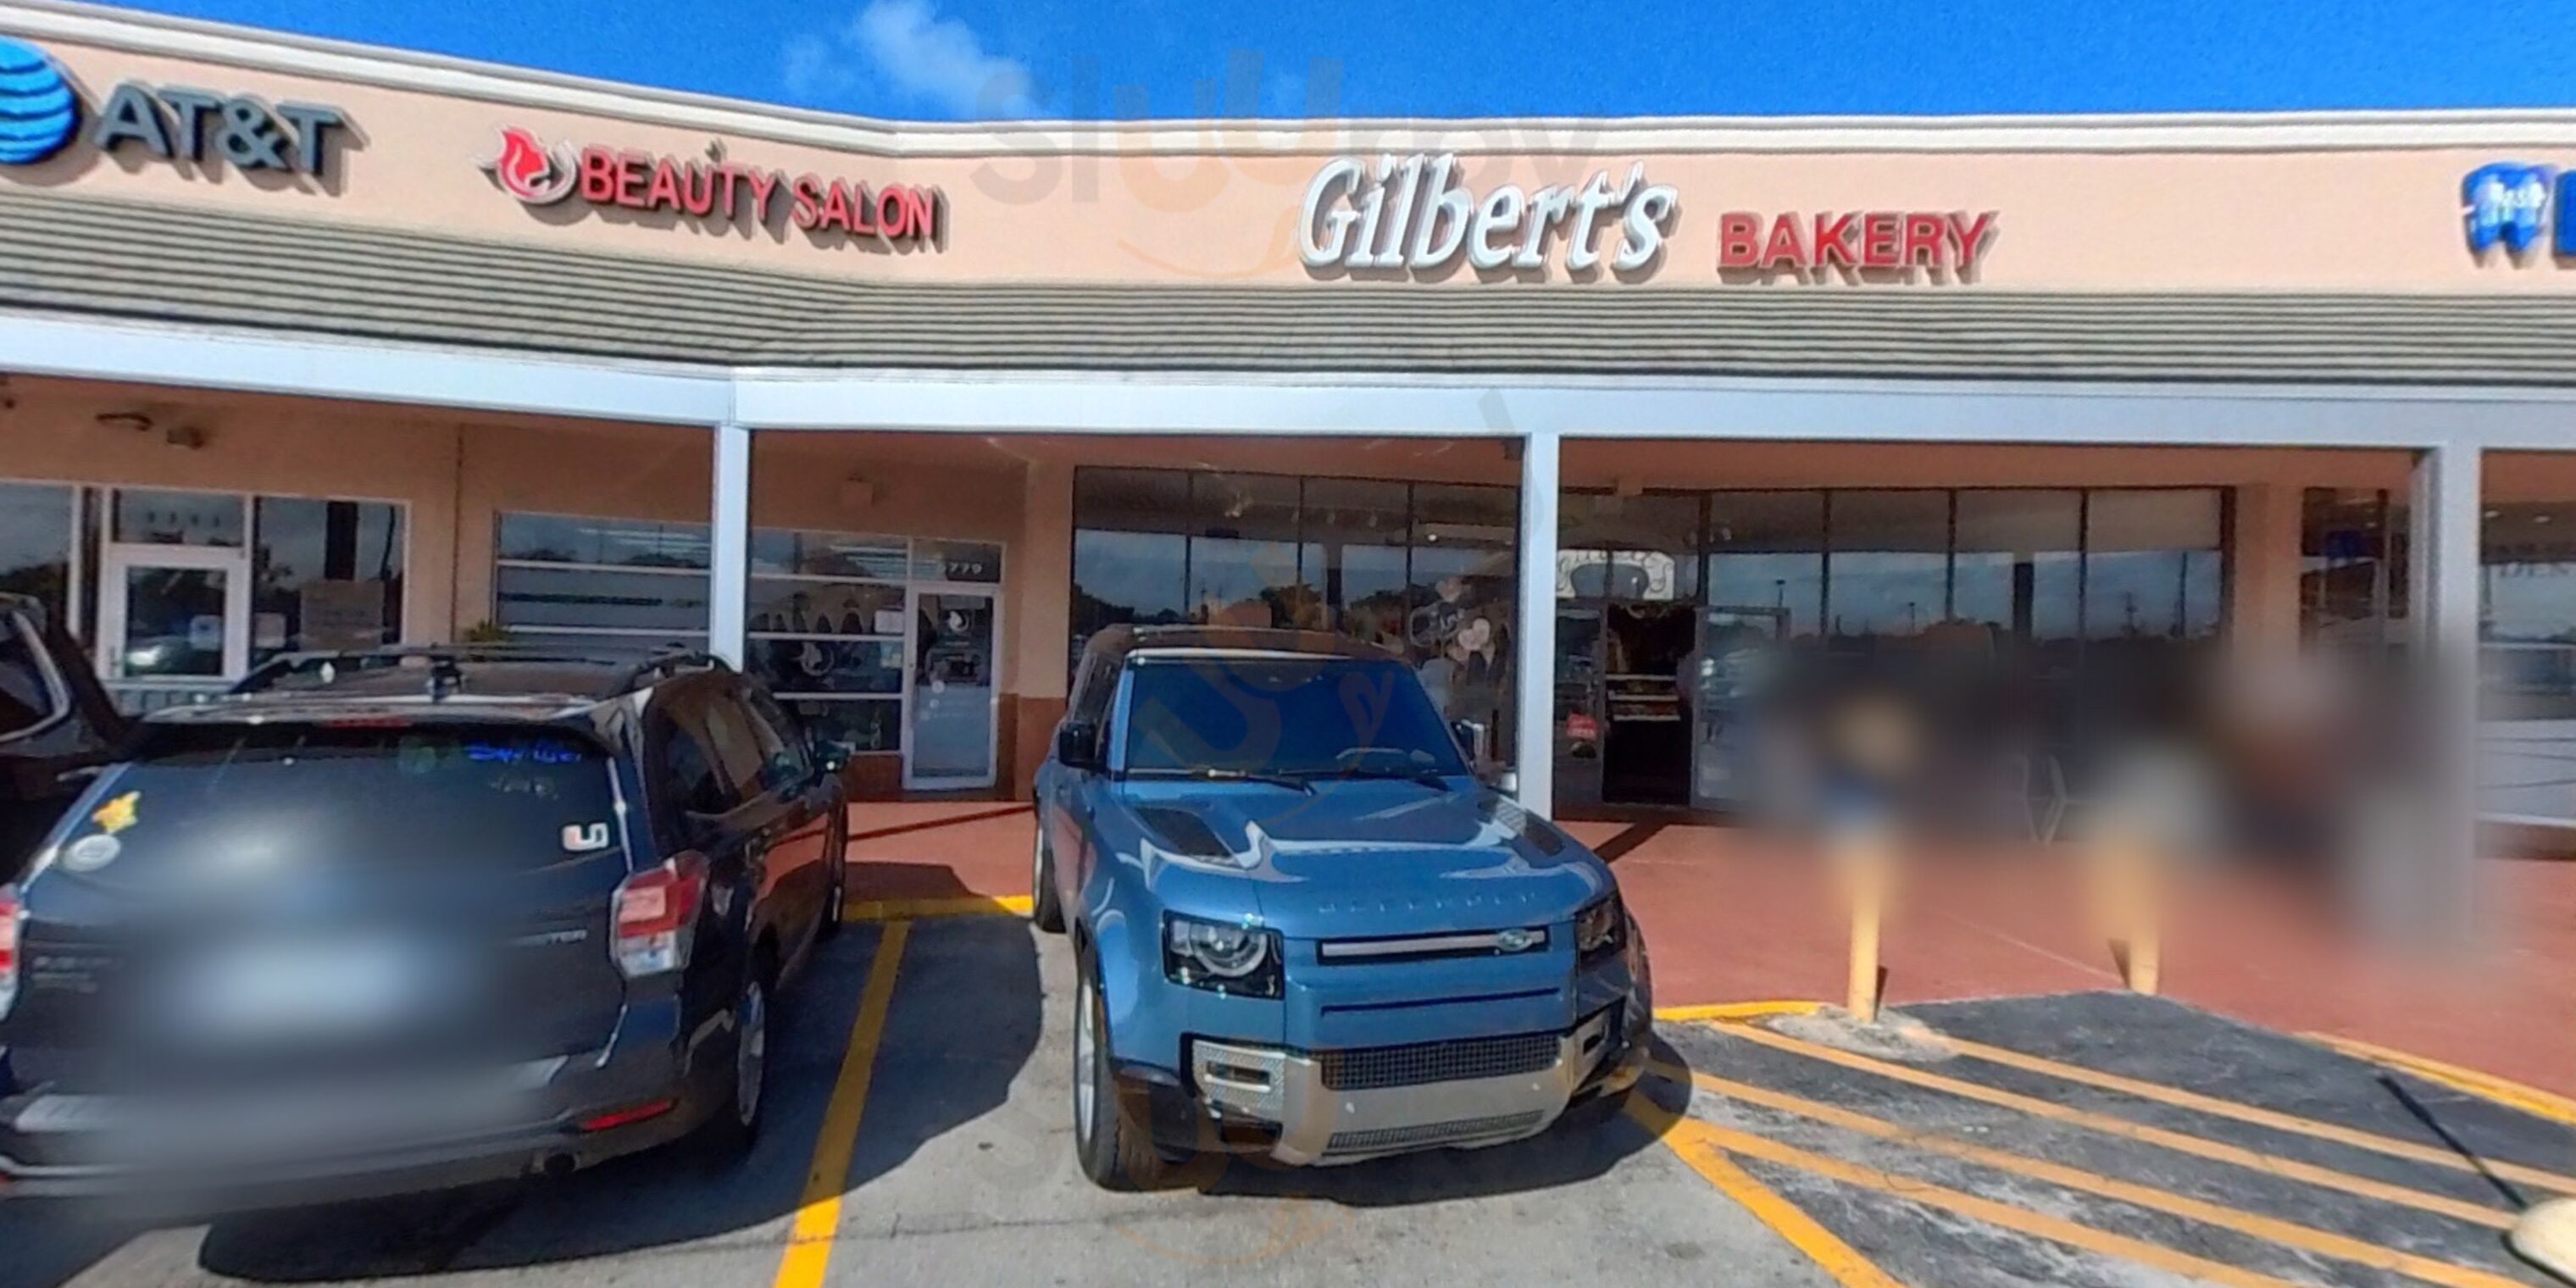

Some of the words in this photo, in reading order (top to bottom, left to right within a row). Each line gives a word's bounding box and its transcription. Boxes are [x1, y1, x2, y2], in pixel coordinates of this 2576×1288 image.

[93, 81, 347, 175] AT&T
[580, 144, 781, 222] BEAUTY
[791, 172, 936, 238] SALON
[1297, 153, 1679, 271] Gilbert's
[1719, 211, 1995, 267] BAKERY
